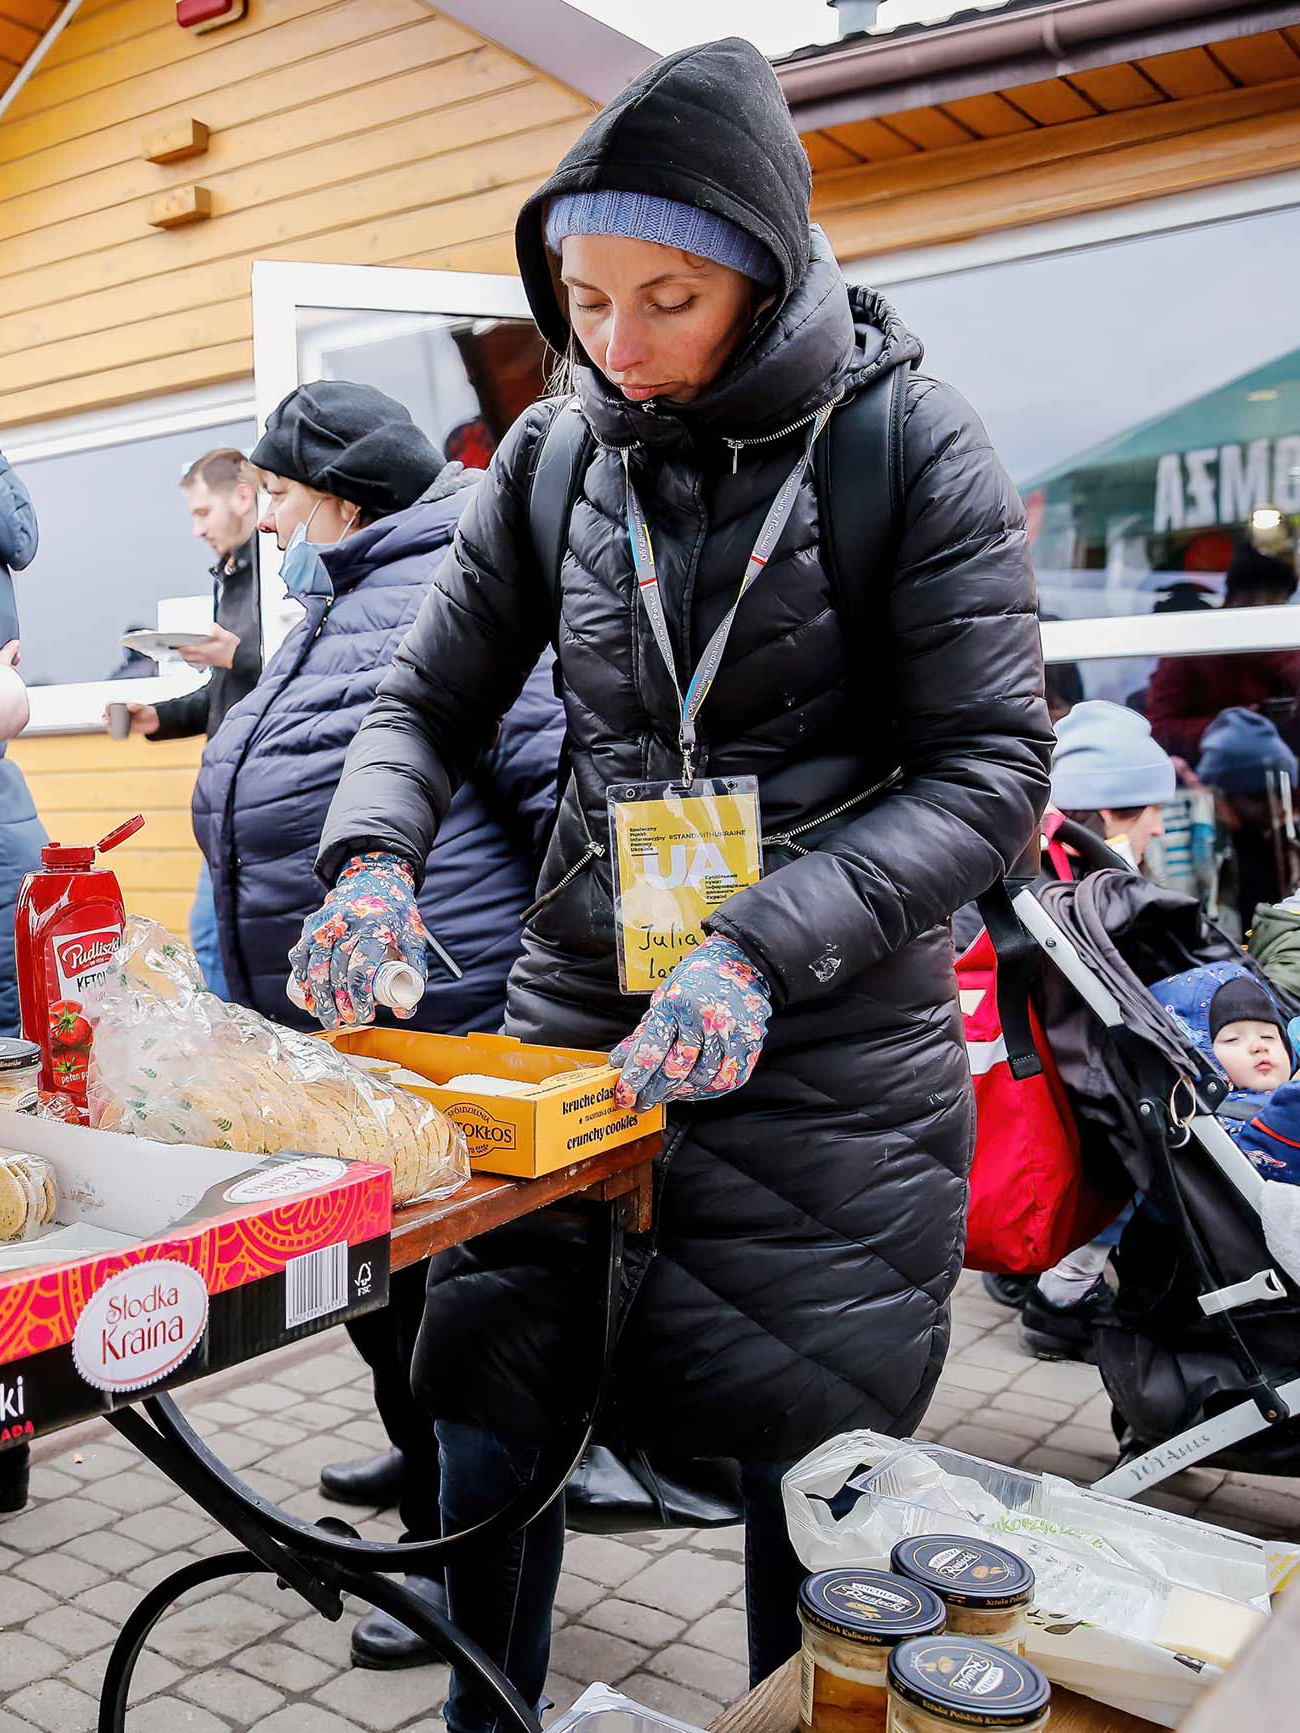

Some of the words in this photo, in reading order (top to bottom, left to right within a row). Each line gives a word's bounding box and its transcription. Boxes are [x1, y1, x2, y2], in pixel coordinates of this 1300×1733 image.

[642, 842, 736, 890] UA
[638, 921, 701, 951] Julia
[562, 1093, 596, 1115] kruche
[566, 1126, 605, 1151] crunchy
[605, 1113, 638, 1137] cookies
[105, 1282, 179, 1325] Słodka
[101, 1313, 184, 1365] Kraina
